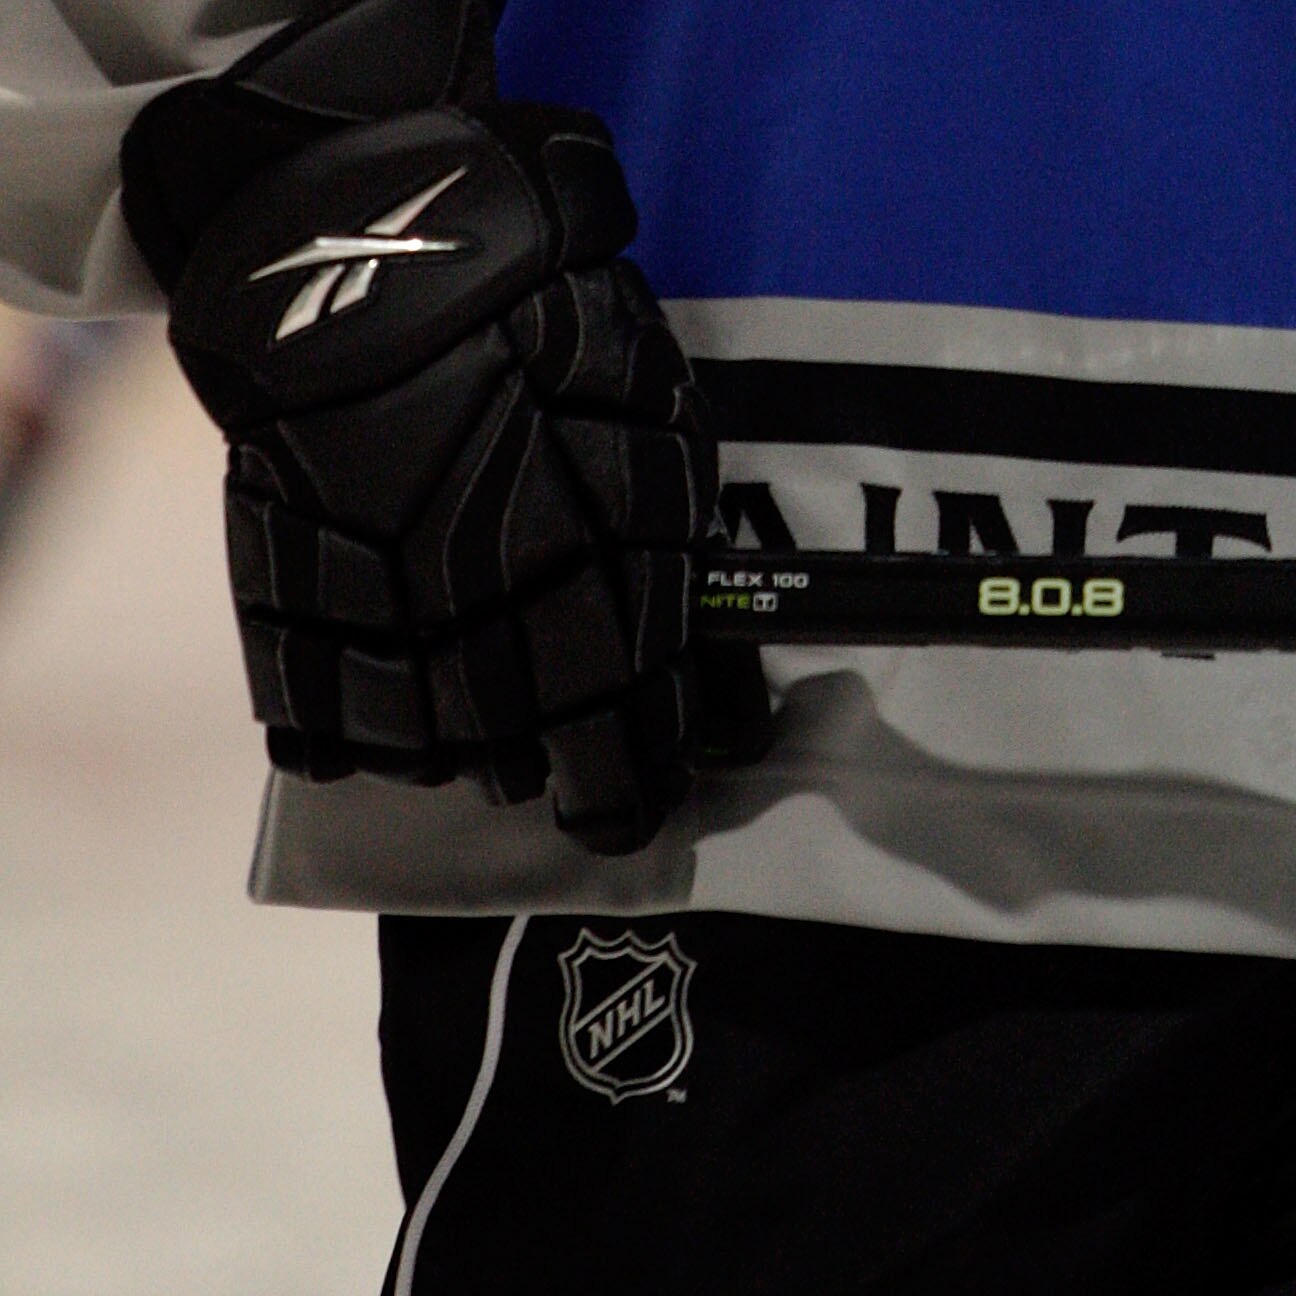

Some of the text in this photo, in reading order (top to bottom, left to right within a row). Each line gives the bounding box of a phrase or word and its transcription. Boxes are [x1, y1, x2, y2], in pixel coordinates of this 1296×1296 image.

[707, 570, 810, 589] FLEX 100
[977, 577, 1125, 618] 8.0.8
[587, 978, 666, 1060] NHL
